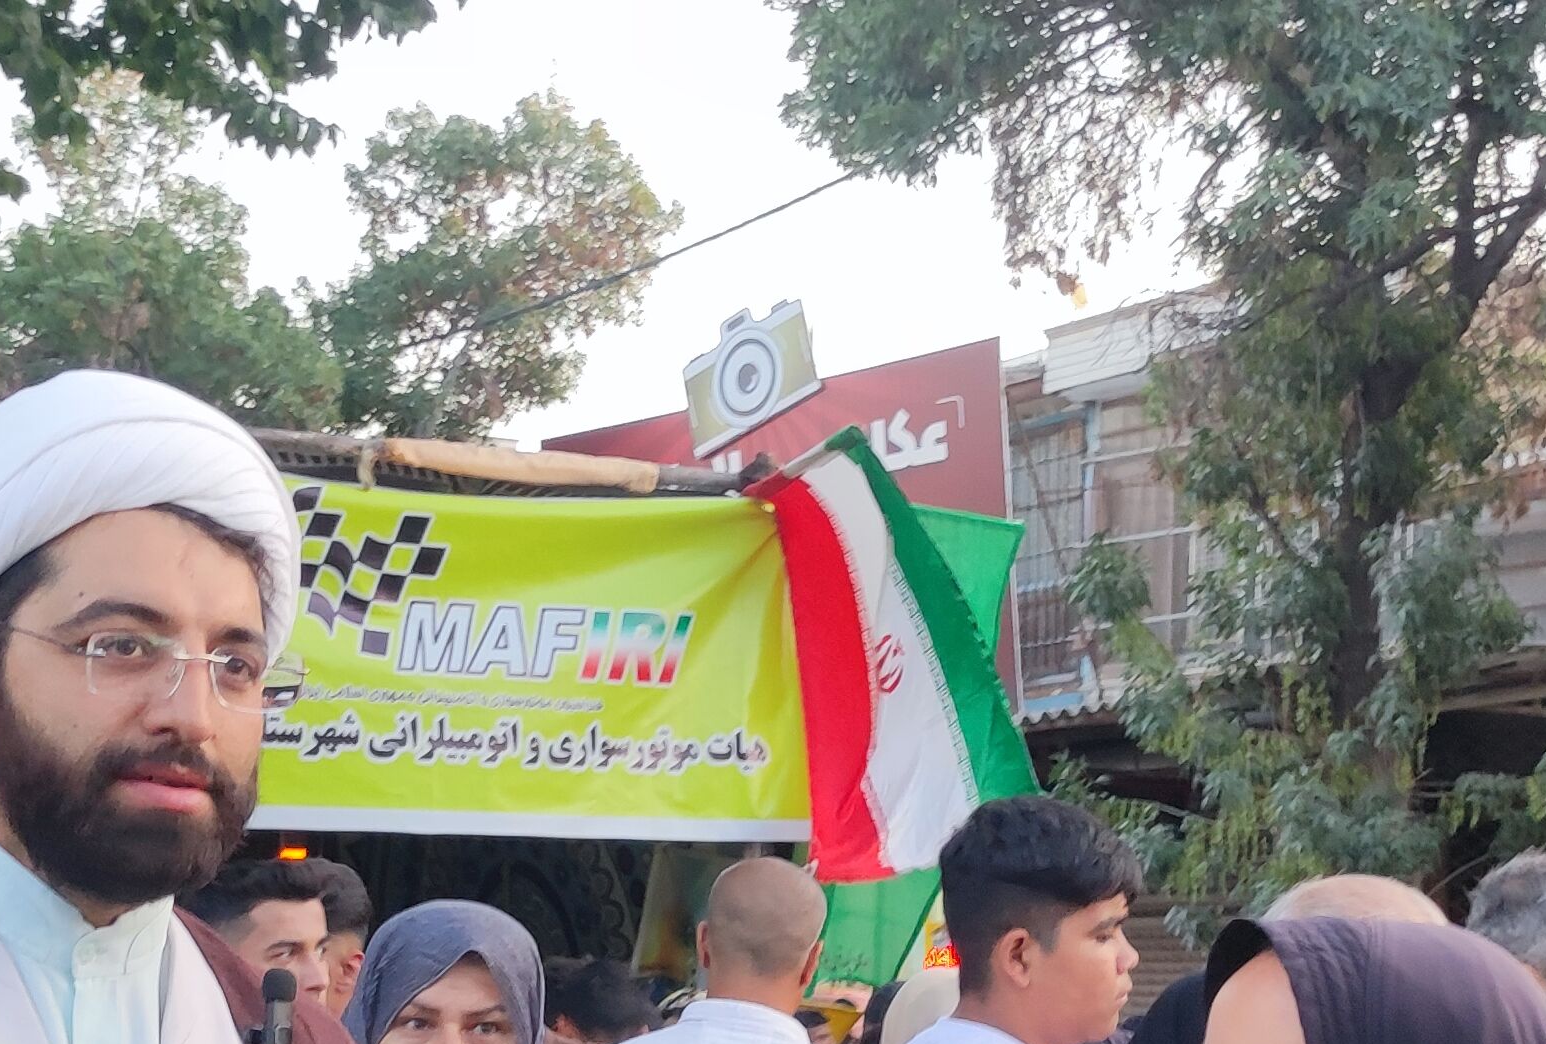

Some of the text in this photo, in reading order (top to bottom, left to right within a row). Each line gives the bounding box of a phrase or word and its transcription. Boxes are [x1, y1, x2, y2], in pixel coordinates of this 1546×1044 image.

[869, 407, 950, 472] عکا
[396, 600, 694, 688] MAFIRI
[261, 713, 360, 758] شهرستا
[368, 712, 519, 766] اتومبیلرانی
[526, 738, 541, 766] و
[547, 722, 699, 771] موتورسواری
